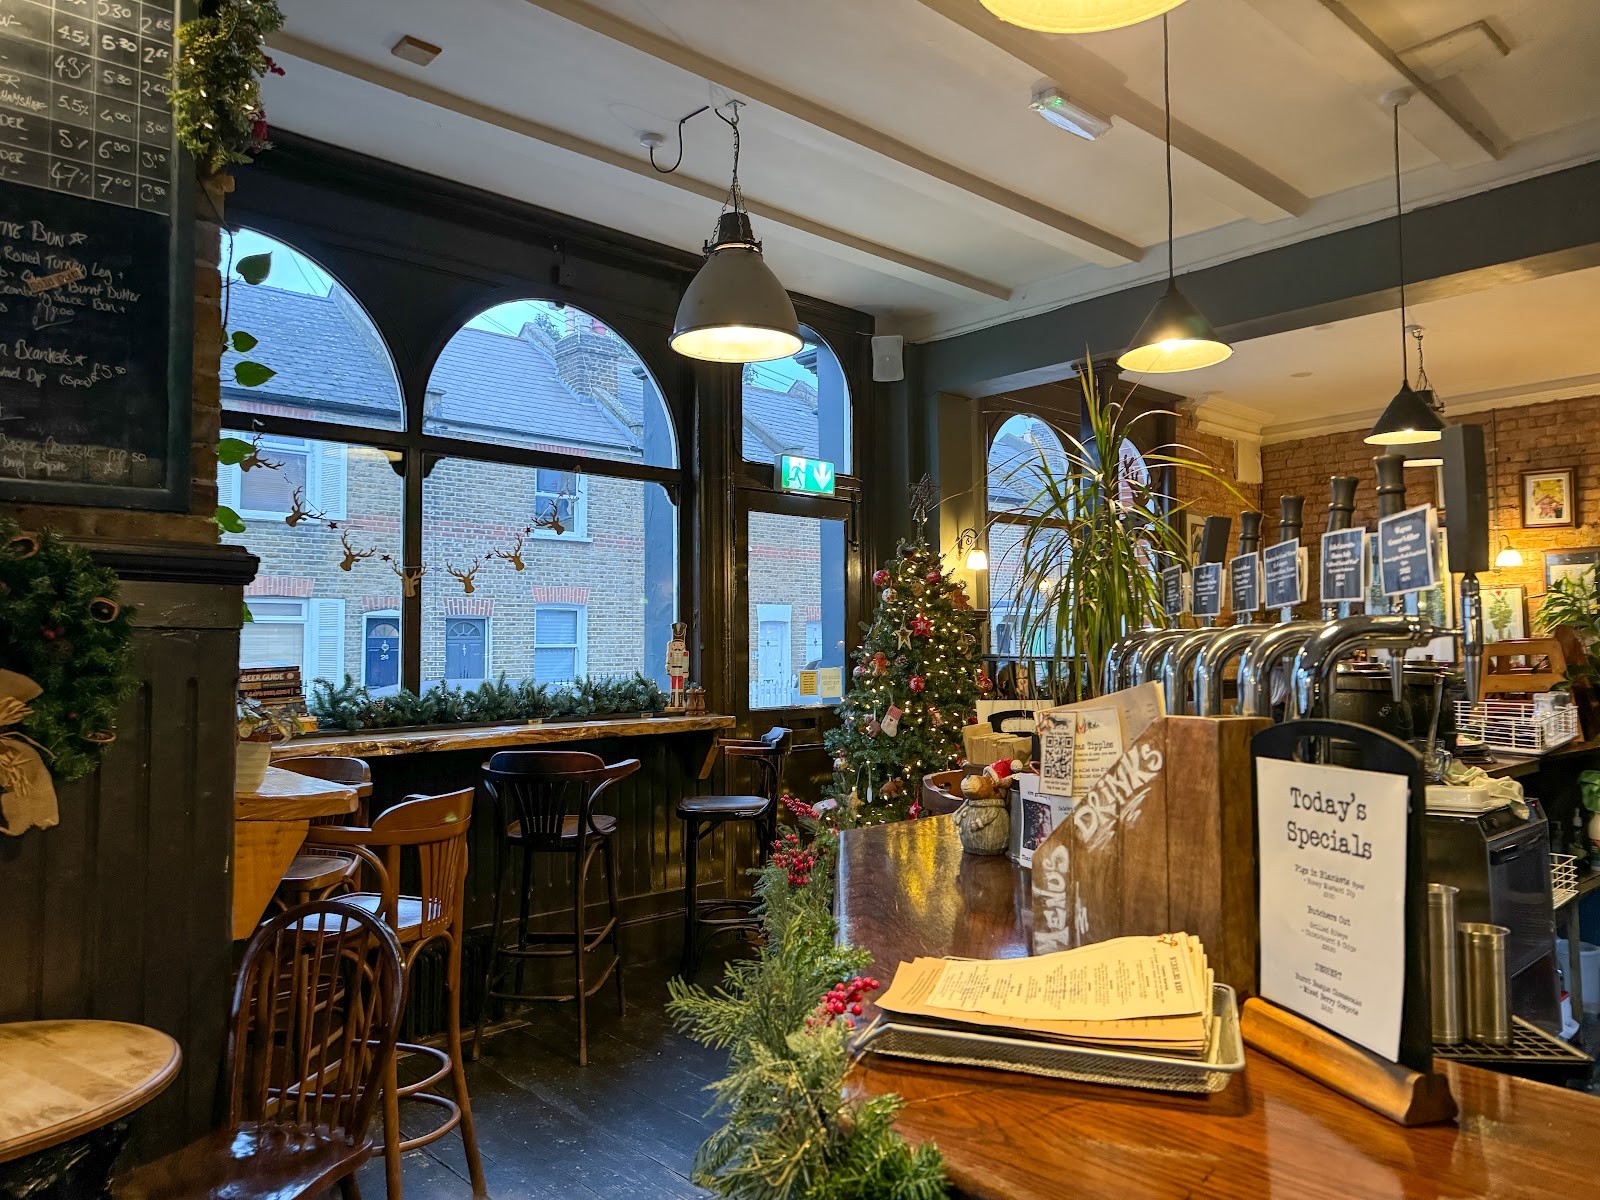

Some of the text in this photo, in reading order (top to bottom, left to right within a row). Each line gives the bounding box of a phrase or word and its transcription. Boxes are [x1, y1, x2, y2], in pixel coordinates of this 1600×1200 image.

[241, 672, 285, 683] BEER GUIDE
[1087, 740, 1113, 751] Tipples
[1290, 787, 1367, 822] Today's
[1287, 820, 1372, 860] Specials
